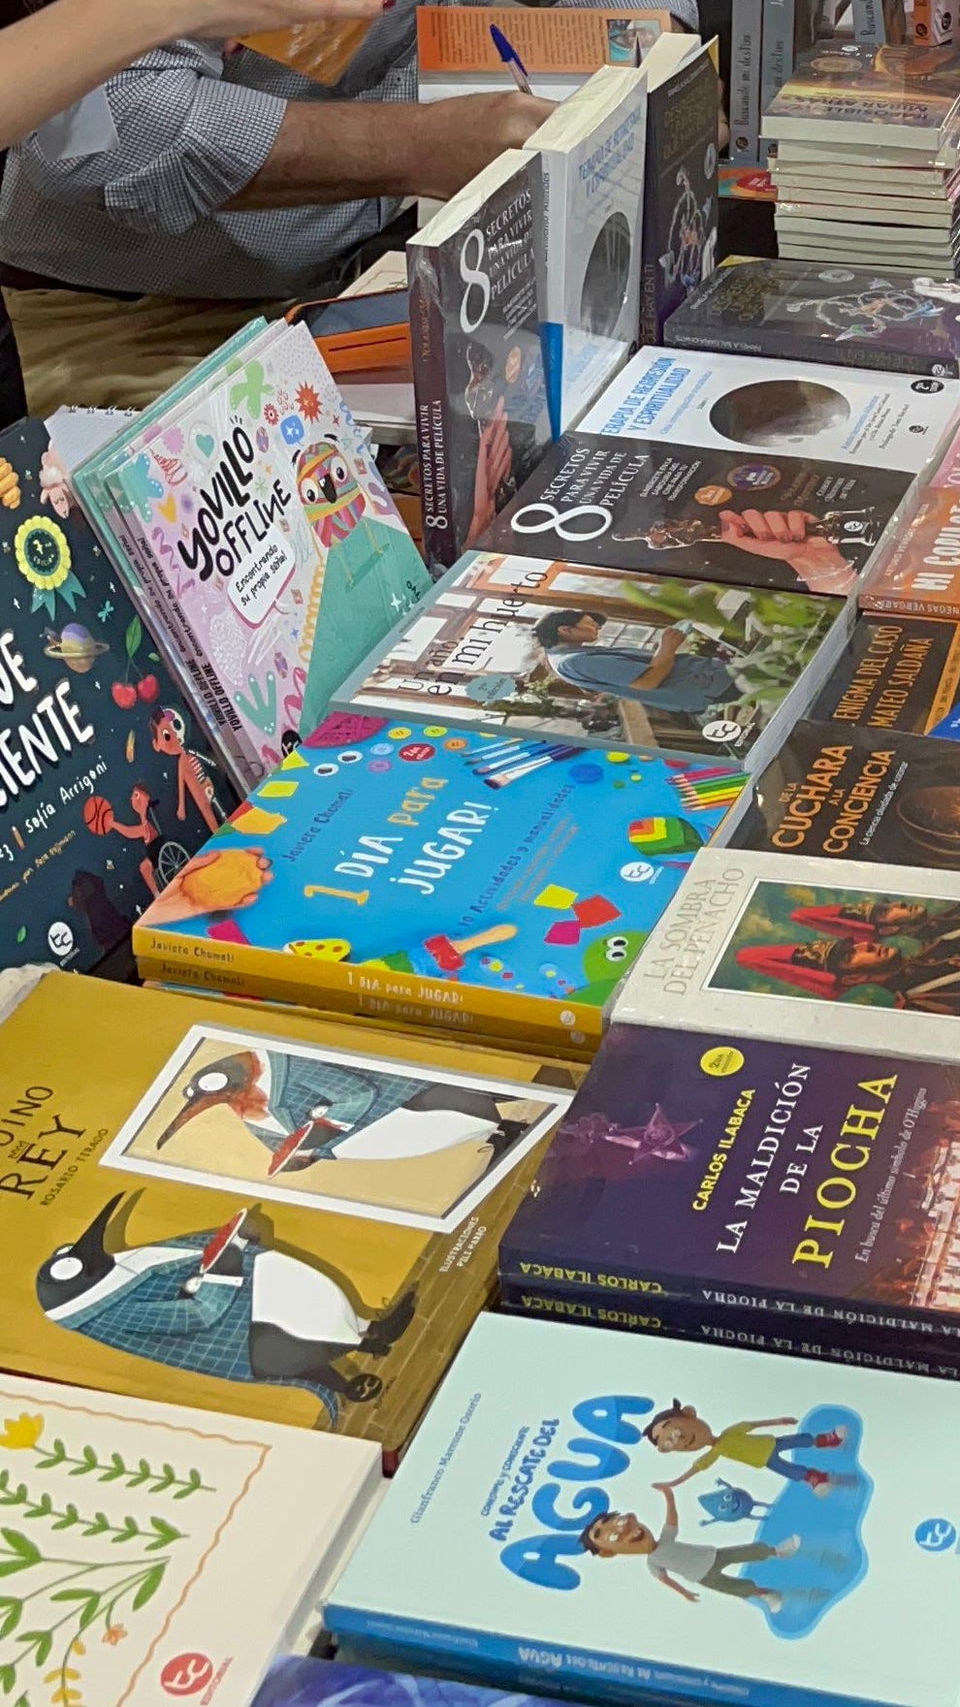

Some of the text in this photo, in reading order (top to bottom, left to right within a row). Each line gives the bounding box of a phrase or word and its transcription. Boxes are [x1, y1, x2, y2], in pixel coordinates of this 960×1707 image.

[734, 81, 751, 127] Buscando
[485, 188, 532, 242] SECRETOS
[460, 227, 491, 334] 8
[490, 246, 536, 301] PELÍCULA
[601, 403, 639, 435] ERAPIA
[634, 367, 692, 427] ESPIRITUALIDAD
[420, 404, 435, 513] SECRETOS PARA VIVIR
[432, 399, 448, 514] UNA VIDA DE PELÍCULA
[540, 446, 591, 501] SECRETOS
[560, 449, 612, 503] PARA VIVIR
[579, 451, 629, 505] UNA VIDA DE
[599, 453, 650, 508] PELÍCULA
[215, 478, 292, 577] OFFLINE
[510, 502, 613, 542] 8
[234, 543, 278, 593] Encontrando
[240, 592, 252, 607] su
[250, 570, 271, 600] propia
[427, 571, 548, 695] en mi huerto
[201, 661, 226, 695] OFFLINE
[399, 671, 435, 691] un
[833, 625, 904, 722] ENIGMA DEL CASO
[867, 637, 935, 728] MATEO SALDAÑA
[218, 694, 243, 732] YOVILLO
[59, 756, 108, 806] Arrigoni
[771, 744, 854, 849] CUCHARA
[778, 781, 799, 804] DE LA
[822, 749, 897, 854] CONCIENCIA
[833, 787, 847, 801] LA
[282, 826, 321, 863] Javiera
[304, 776, 449, 907] 1 DÍA para
[470, 853, 522, 915] Actividades
[524, 783, 577, 844] manualidades
[859, 837, 871, 846] La
[149, 936, 191, 957] Javiera
[643, 878, 717, 981] LA SOMBRA
[663, 868, 745, 996] DEL PENACHO
[346, 970, 354, 987] 1
[385, 981, 413, 1000] para
[0, 1113, 87, 1200] REY
[692, 1088, 756, 1211] CARLOS ILABACA
[716, 1062, 811, 1254] LA MALDICIÓN
[779, 1124, 824, 1195] DE LA
[899, 1127, 914, 1142] de
[40, 1128, 109, 1206] ROSARIO TIRADO
[792, 1074, 898, 1270] PIOCHA
[875, 1175, 896, 1206] último
[860, 1222, 878, 1249] busca
[870, 1203, 885, 1225] del
[519, 1261, 663, 1294] CARLOS ILABACA
[855, 1246, 872, 1263] En
[521, 1294, 662, 1330] CARLOS ILABACA
[702, 1289, 769, 1310] PIOCHA
[772, 1300, 798, 1313] LA
[802, 1304, 825, 1318] DE
[834, 1308, 932, 1336] MALDICIÓN
[701, 1324, 761, 1345] PIOCHA
[772, 1337, 794, 1350] LA
[801, 1341, 823, 1354] DE
[937, 1363, 960, 1378] LA
[410, 1465, 445, 1524] Gianfranco
[462, 1392, 482, 1427] Osorio
[489, 1518, 513, 1542] AL
[504, 1452, 547, 1517] RESCATE
[538, 1417, 561, 1453] DEL
[499, 1394, 656, 1591] AGUA
[517, 1645, 563, 1668] AGUA
